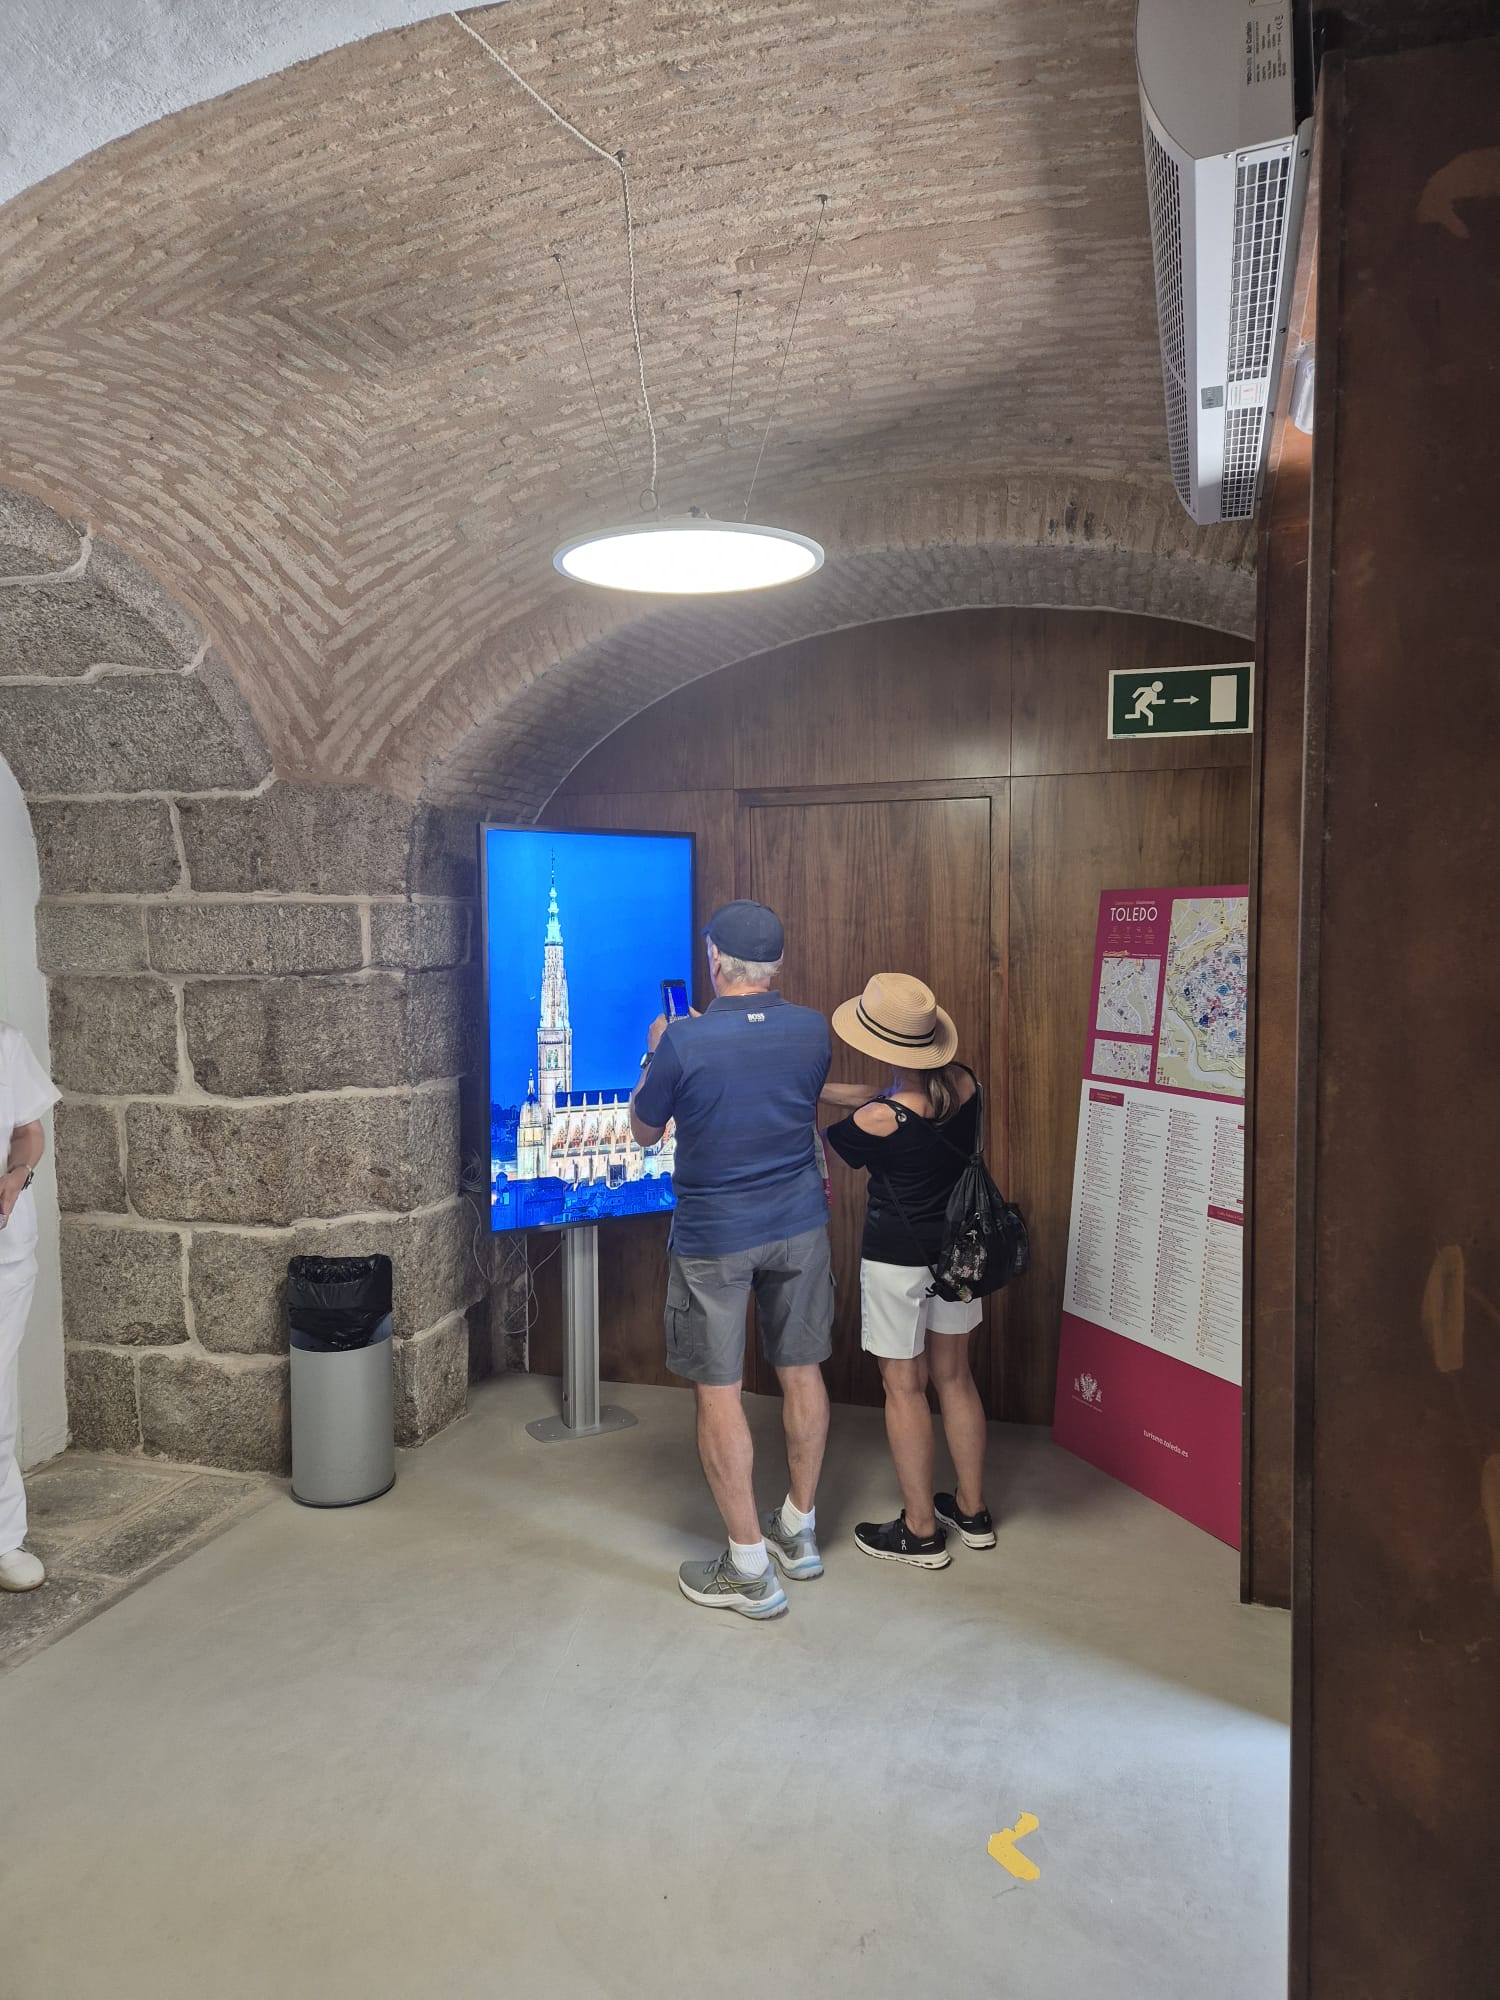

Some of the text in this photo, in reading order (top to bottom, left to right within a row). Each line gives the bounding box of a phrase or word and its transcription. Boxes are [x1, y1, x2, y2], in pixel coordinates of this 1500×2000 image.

[1110, 906, 1158, 922] TOLEDO
[747, 1013, 764, 1021] BOSS
[1143, 1429, 1189, 1458] turismo.toledo.es
